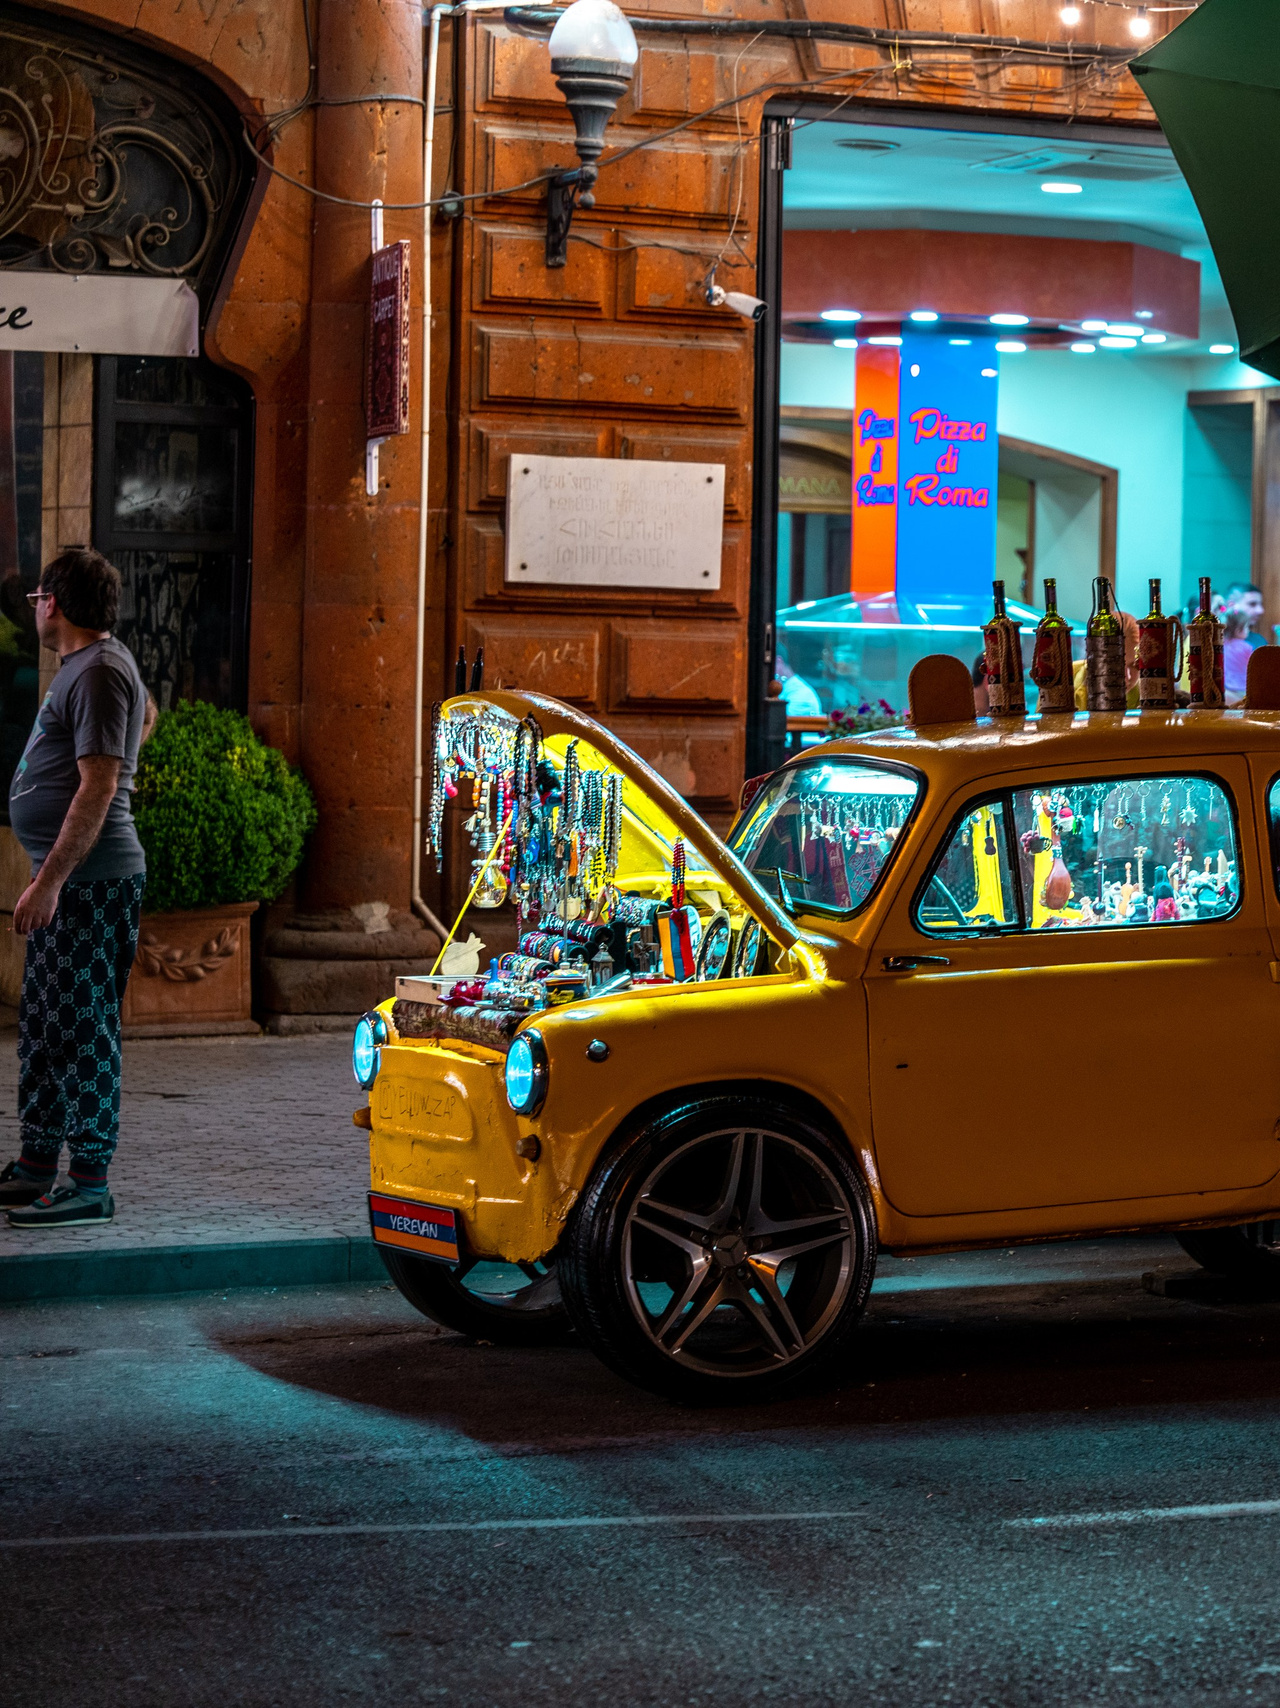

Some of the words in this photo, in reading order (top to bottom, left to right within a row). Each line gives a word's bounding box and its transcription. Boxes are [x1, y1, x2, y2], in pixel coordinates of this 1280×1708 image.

[374, 294, 396, 323] CARPET
[909, 407, 987, 444] Pizza
[935, 443, 960, 474] di
[904, 473, 990, 508] Roma
[389, 1213, 438, 1239] YEREVAN
